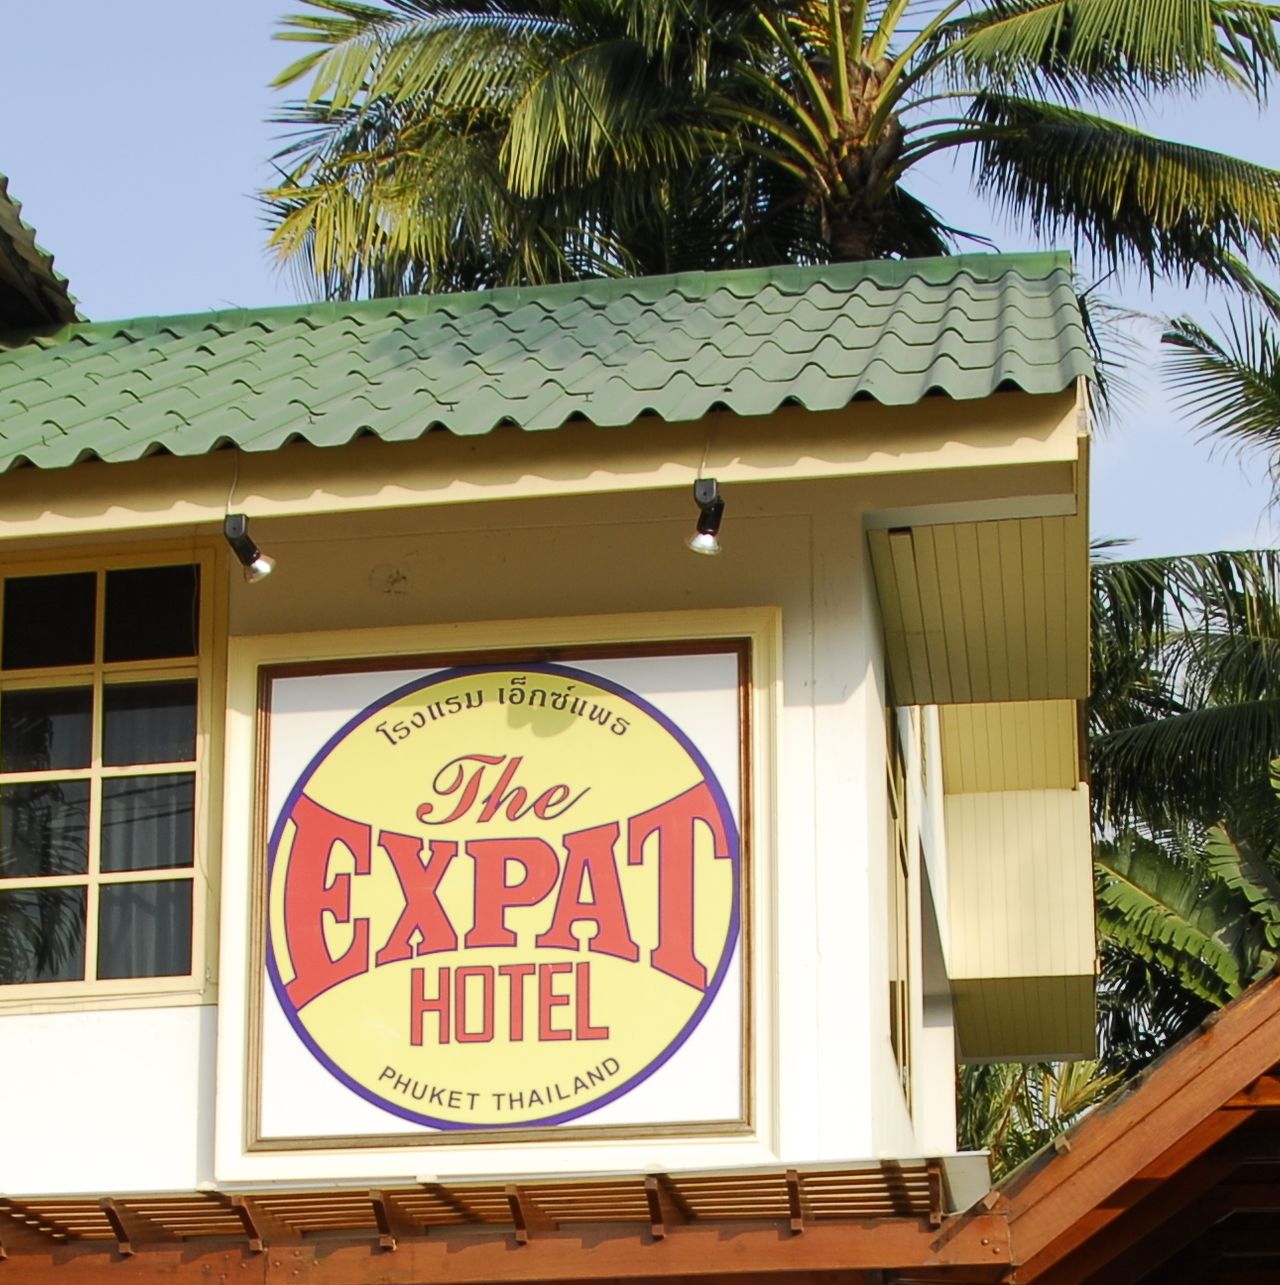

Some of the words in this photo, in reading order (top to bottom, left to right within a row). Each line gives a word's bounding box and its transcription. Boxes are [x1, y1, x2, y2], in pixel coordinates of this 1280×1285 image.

[376, 689, 484, 745] โรงแรม
[416, 754, 591, 825] The
[283, 780, 732, 1014] EXPAT
[410, 961, 610, 1046] HOTEL
[378, 1065, 480, 1110] PHUKET
[492, 1057, 620, 1111] THAILAND
